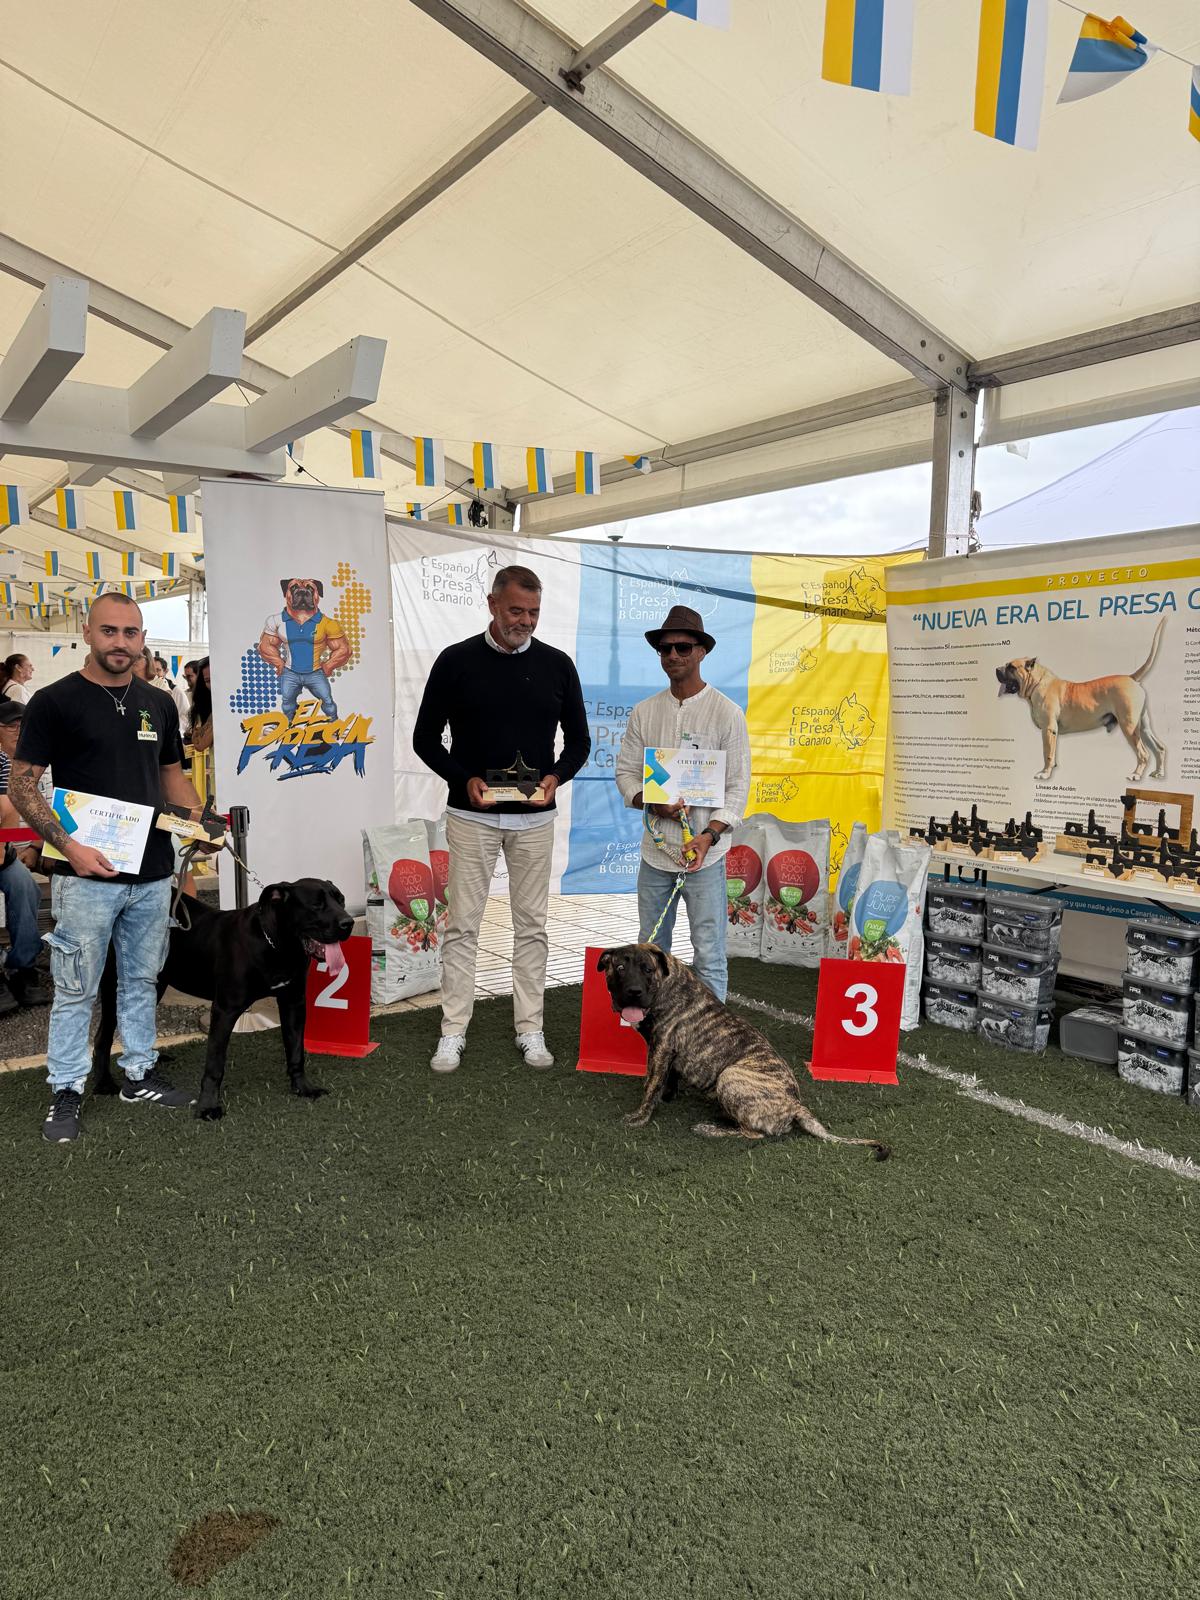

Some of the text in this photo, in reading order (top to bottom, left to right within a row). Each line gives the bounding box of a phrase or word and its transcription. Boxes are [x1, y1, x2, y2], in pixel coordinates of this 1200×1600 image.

[431, 558, 474, 574] Español
[433, 574, 473, 593] Presa
[629, 577, 670, 589] Español
[1046, 567, 1149, 587] PROYECTO
[810, 579, 848, 590] Español
[431, 588, 474, 606] Canario
[630, 592, 669, 607] Presa
[813, 595, 849, 607] Presa
[813, 605, 850, 618] Canario
[996, 603, 1040, 625] ERA
[1047, 599, 1089, 621] DEL
[1099, 590, 1177, 617] PRESA
[291, 699, 333, 727] EL
[800, 705, 838, 717] Español
[799, 721, 834, 734] Presa
[237, 711, 376, 779] PRESA
[798, 734, 832, 747] Canario
[89, 808, 140, 824] CERTIFICADO
[782, 855, 806, 864] DAILY
[780, 863, 807, 874] FOOD
[781, 873, 804, 883] MAXI
[1074, 901, 1087, 909] que
[1087, 901, 1105, 911] nadie
[1106, 905, 1124, 914] ajeno
[314, 960, 350, 1010] 2
[841, 982, 879, 1037] 3
